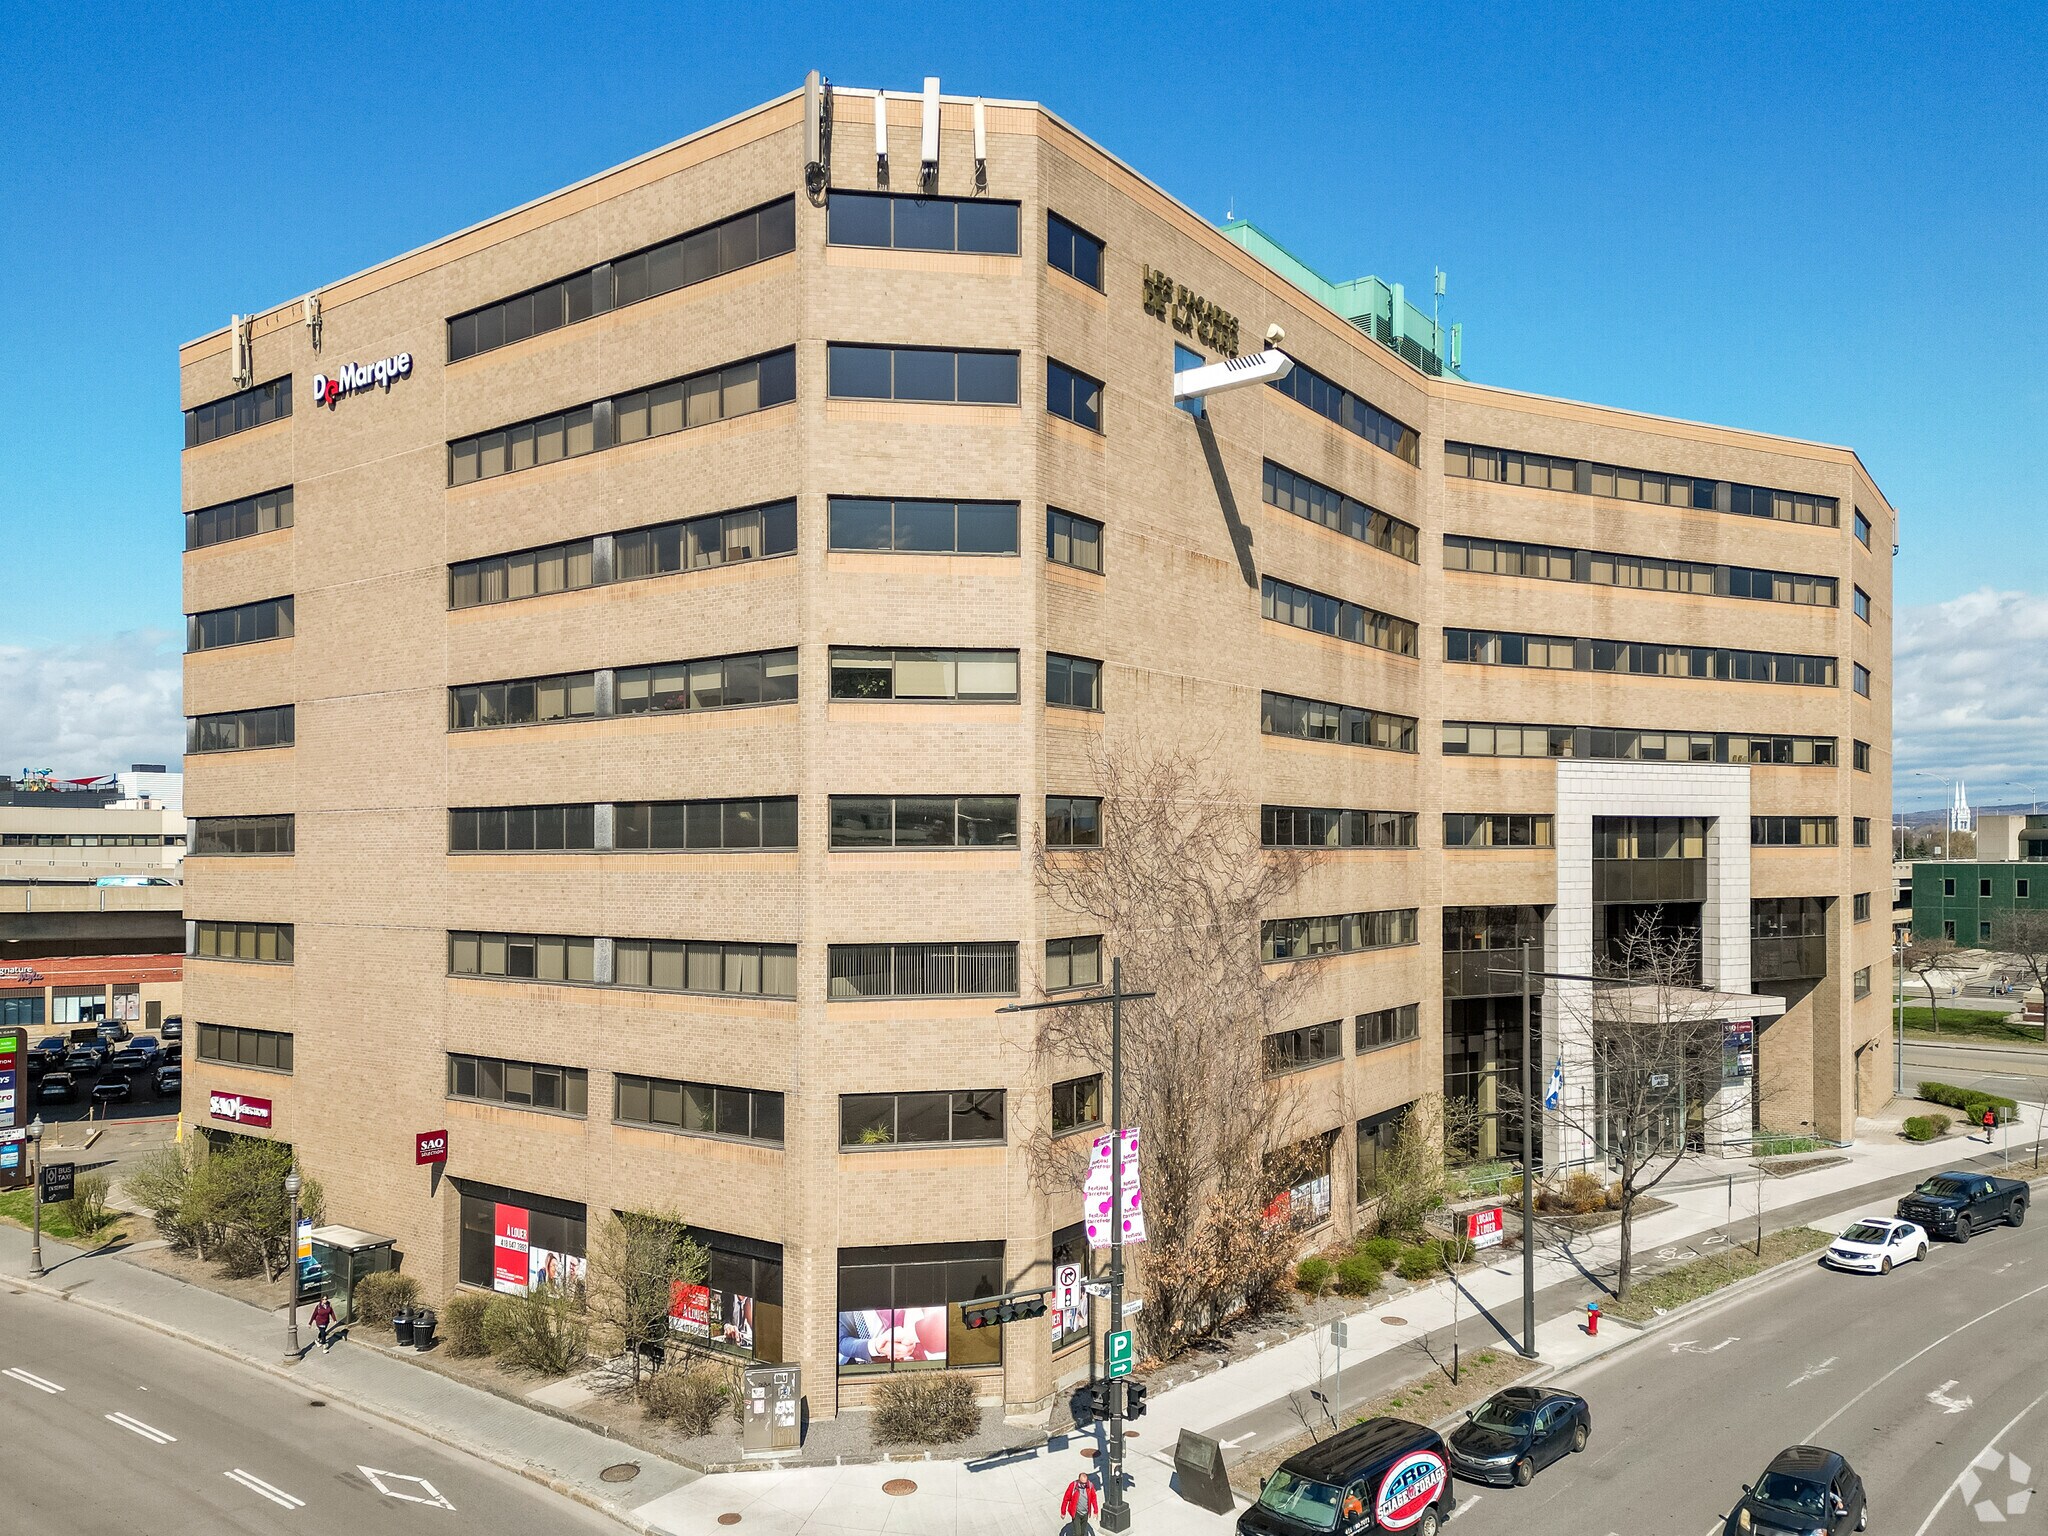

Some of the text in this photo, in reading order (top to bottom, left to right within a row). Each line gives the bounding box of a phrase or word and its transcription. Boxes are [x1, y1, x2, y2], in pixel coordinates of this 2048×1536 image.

[1143, 263, 1174, 296] LES
[1143, 287, 1240, 355] DE LA GARE
[0, 966, 33, 975] gnature
[210, 1096, 236, 1117] SAQ
[57, 1166, 72, 1174] BUS
[511, 1226, 528, 1240] LOUER
[1114, 1335, 1127, 1358] P
[1389, 1464, 1430, 1496] PRO
[1377, 1487, 1411, 1519] SCIAGE
[1414, 1465, 1447, 1497] FORAGE
